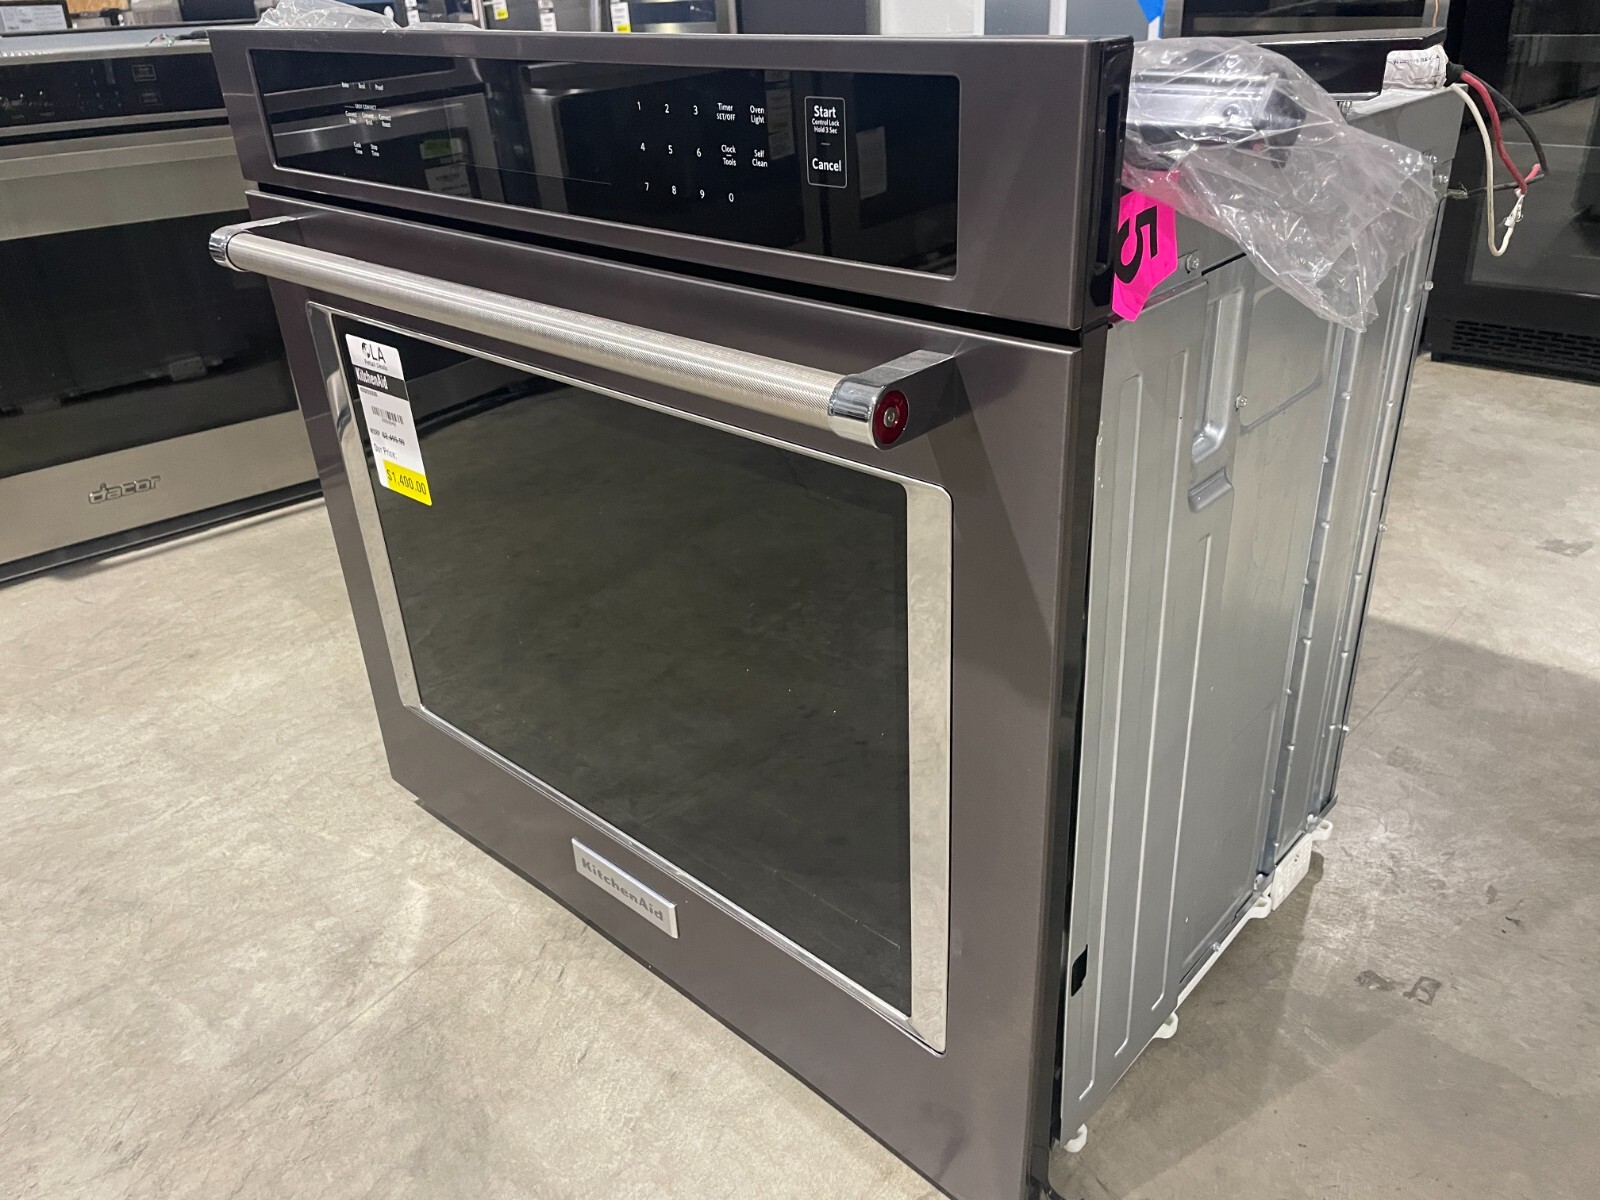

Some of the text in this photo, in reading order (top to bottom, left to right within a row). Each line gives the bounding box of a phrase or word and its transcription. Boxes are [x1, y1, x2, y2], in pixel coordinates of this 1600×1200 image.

[664, 103, 670, 114] 2
[693, 104, 699, 116] 3
[717, 102, 735, 112] Timer
[749, 104, 765, 114] Oven
[813, 104, 837, 119] Start
[716, 112, 736, 121] SET/OFF
[750, 114, 765, 125] Light
[811, 117, 840, 127] Control Lock
[813, 125, 825, 133] Hold
[829, 126, 838, 134] Sec
[640, 142, 702, 158] 4 5 6
[720, 144, 737, 154] Clock
[722, 157, 737, 167] Tools
[751, 158, 768, 168] Clean
[811, 157, 842, 172] Cancel
[644, 181, 735, 203] 7 8 9 0
[354, 366, 389, 390] KitchenAid
[386, 468, 427, 495] $1,400.00
[88, 475, 161, 504] dacor
[581, 857, 664, 922] KitchenAid
